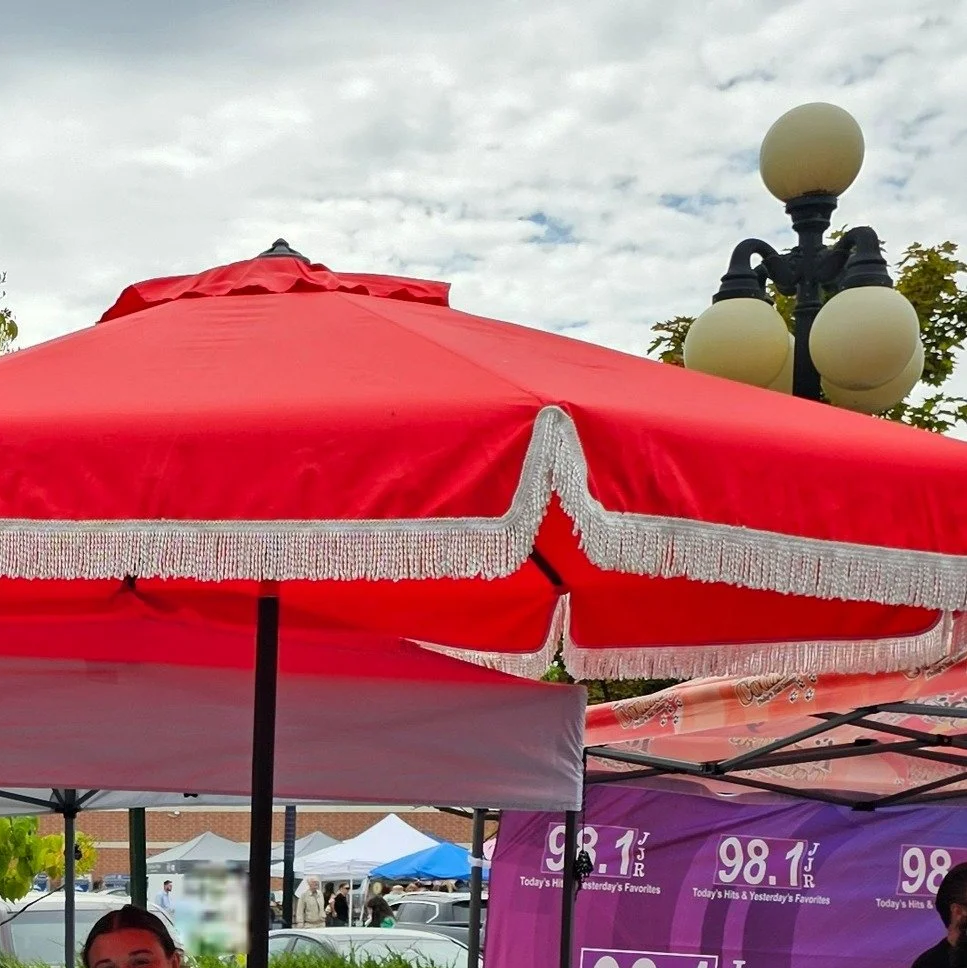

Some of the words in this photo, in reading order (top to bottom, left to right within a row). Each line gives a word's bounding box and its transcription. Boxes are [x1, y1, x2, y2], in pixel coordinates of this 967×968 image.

[545, 825, 634, 876] 98.1
[718, 836, 804, 887] 98.1
[520, 876, 550, 889] Today's
[552, 878, 564, 888] Hit
[582, 881, 623, 894] esterday's
[624, 883, 661, 895] Favorites
[901, 847, 952, 895] 98
[692, 887, 722, 900] Today's
[724, 889, 740, 900] Hits
[741, 891, 748, 900] &
[749, 891, 793, 904] Yesterday's
[795, 894, 831, 906] Favorites
[875, 898, 907, 910] Today's
[908, 899, 925, 909] Hits
